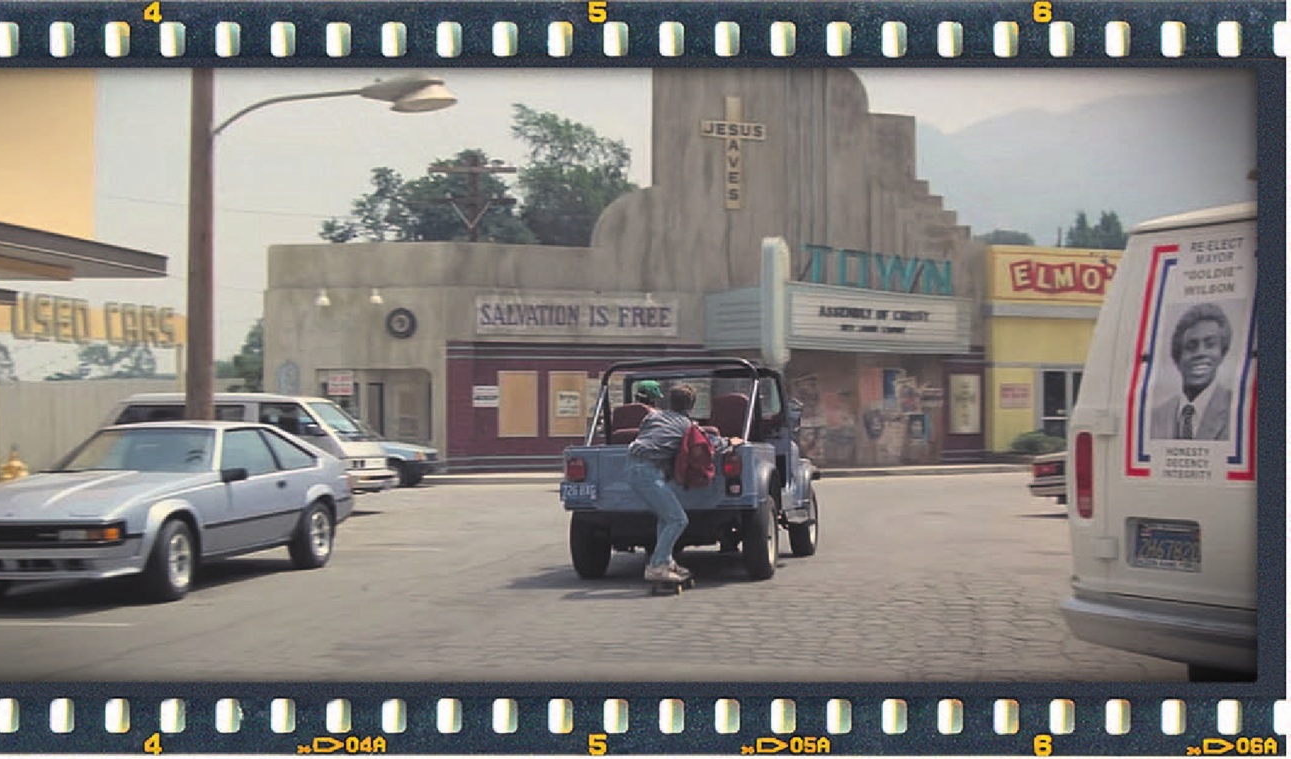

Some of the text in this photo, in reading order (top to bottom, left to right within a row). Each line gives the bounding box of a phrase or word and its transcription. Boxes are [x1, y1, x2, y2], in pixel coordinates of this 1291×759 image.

[704, 123, 763, 138] JESUS
[1190, 237, 1244, 252] RE-ELECT
[1195, 251, 1235, 263] MAYOR
[801, 244, 953, 296] TOWN
[1184, 283, 1235, 296] WILSON
[11, 292, 175, 348] USED CARS
[480, 304, 673, 328] SALVATION IS FREE
[1166, 447, 1210, 457] HONESTY
[1166, 458, 1210, 468] DECENCY
